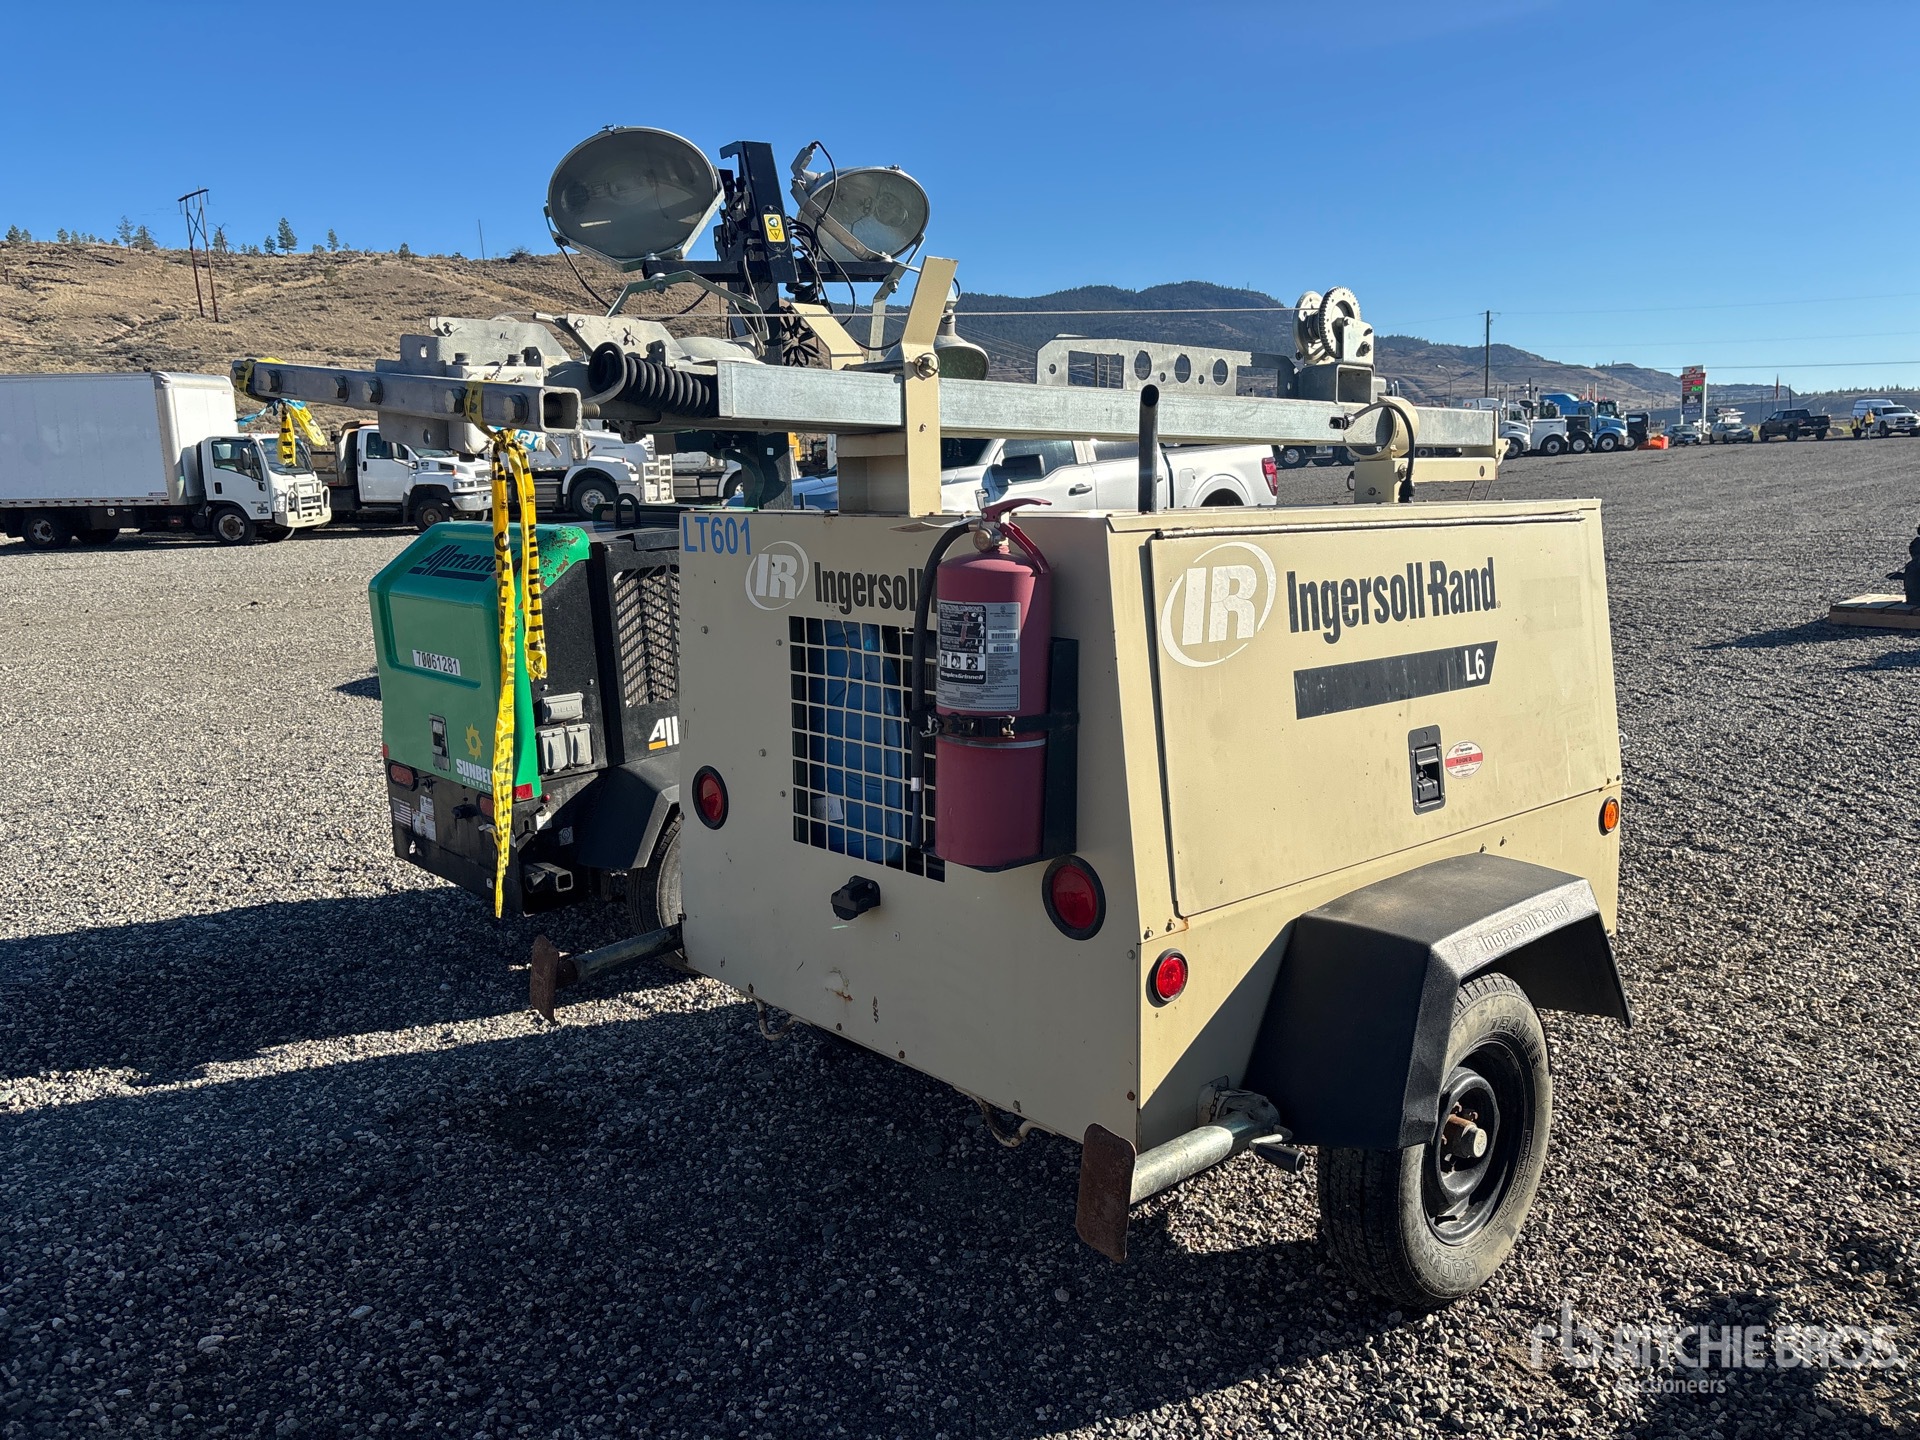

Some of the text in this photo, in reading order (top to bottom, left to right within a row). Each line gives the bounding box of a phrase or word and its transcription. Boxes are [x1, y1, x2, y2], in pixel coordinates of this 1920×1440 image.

[683, 516, 751, 555] LT601
[755, 553, 798, 600] IR
[1182, 564, 1258, 646] IR
[416, 651, 458, 674] 70061281
[1464, 647, 1486, 681] L6
[455, 758, 494, 785] SUNBEL
[462, 776, 493, 792] RENTALS
[1490, 1015, 1544, 1070] TRAILER
